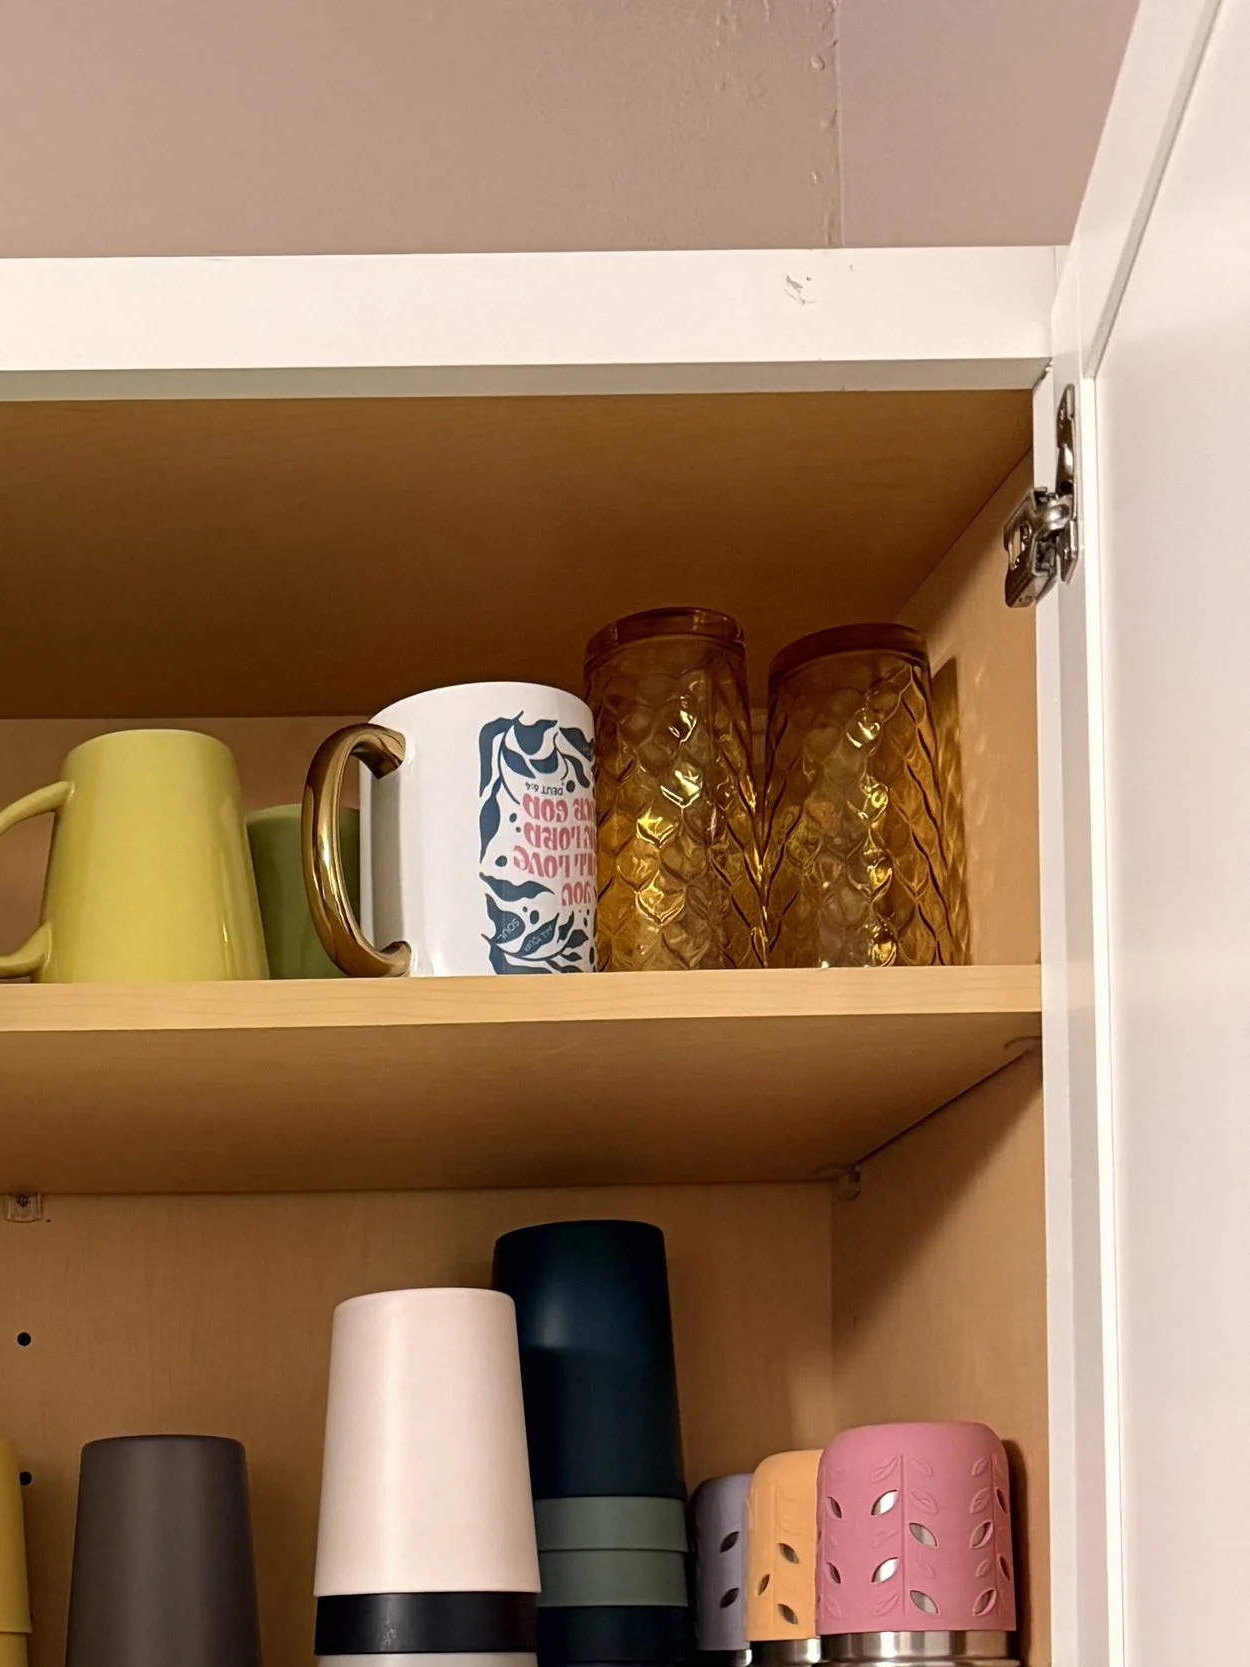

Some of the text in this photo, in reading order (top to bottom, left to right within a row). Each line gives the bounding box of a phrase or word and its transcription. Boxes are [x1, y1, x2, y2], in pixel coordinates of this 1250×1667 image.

[541, 785, 564, 797] DEUT
[522, 793, 568, 823] GOD
[523, 821, 580, 851] LORD
[513, 845, 570, 879] LOVE
[561, 881, 592, 907] YOU
[497, 917, 521, 941] SOUL
